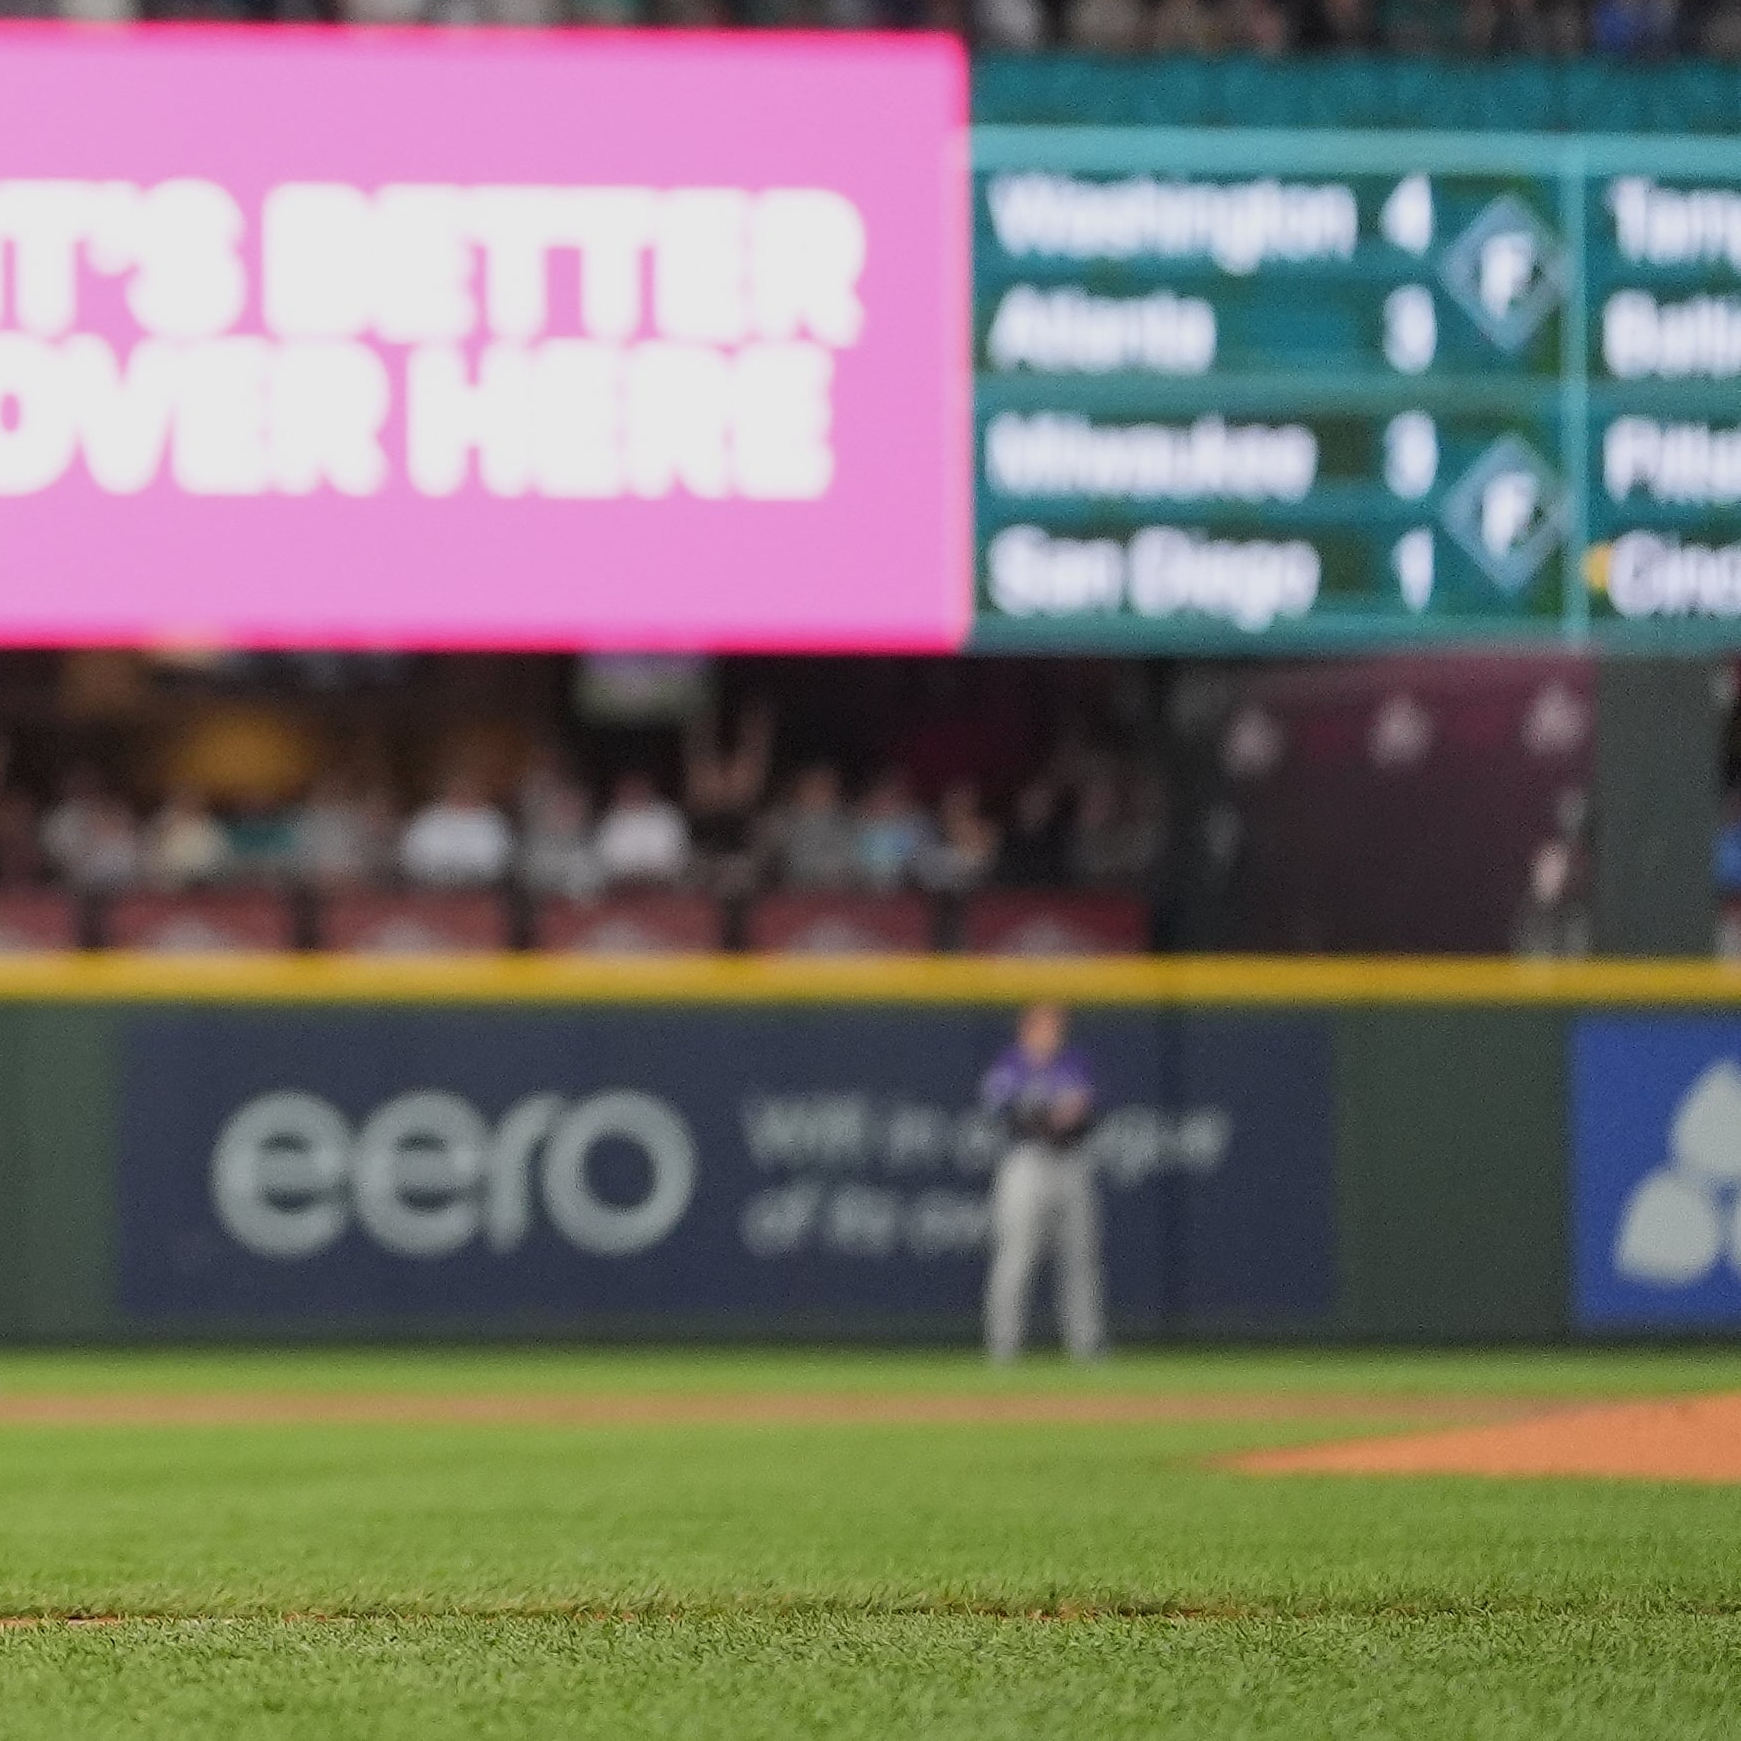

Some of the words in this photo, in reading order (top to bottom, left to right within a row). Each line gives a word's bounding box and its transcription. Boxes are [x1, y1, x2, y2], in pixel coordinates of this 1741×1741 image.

[261, 181, 867, 348] BETTER
[406, 335, 834, 501] HERE
[210, 1087, 699, 1257] eero
